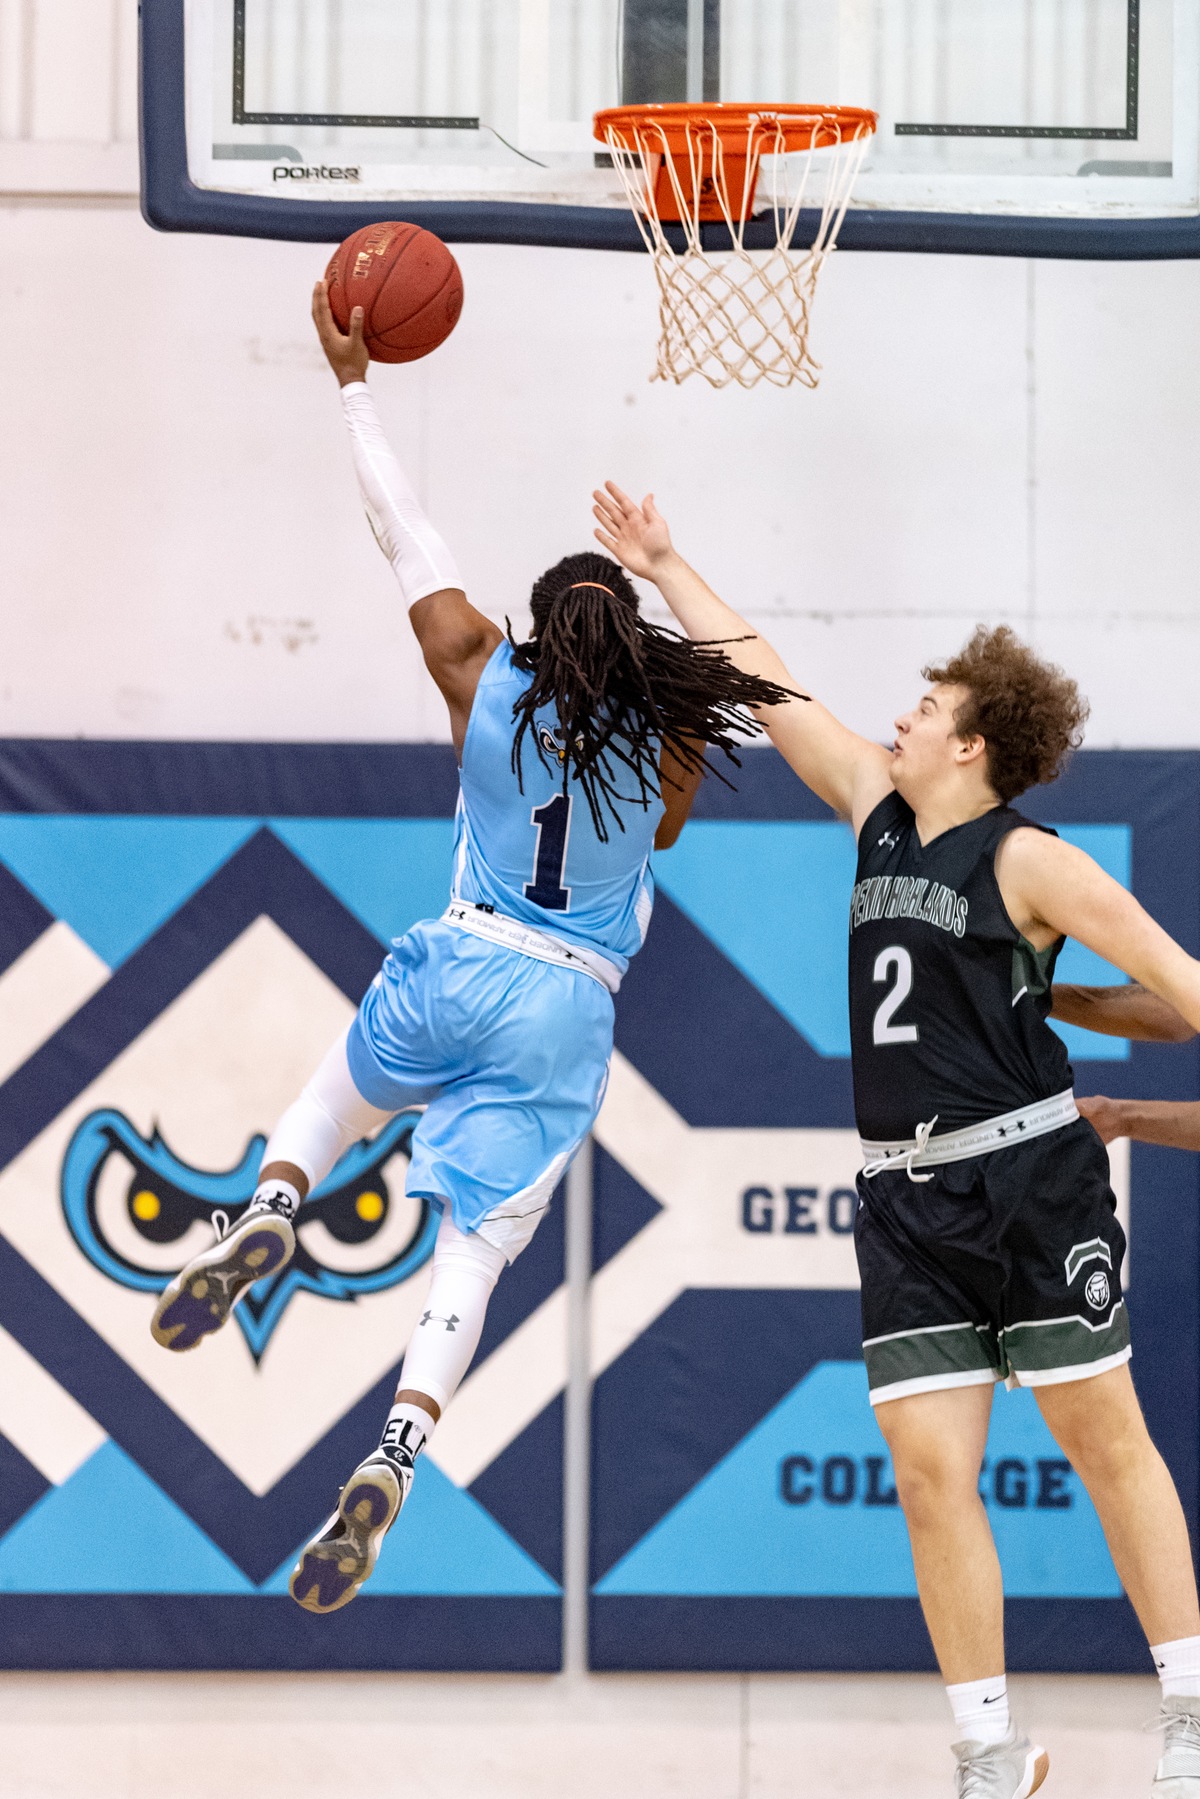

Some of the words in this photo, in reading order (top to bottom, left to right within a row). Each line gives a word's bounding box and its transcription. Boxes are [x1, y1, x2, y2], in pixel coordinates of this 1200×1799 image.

[522, 793, 573, 914] 1
[872, 946, 919, 1046] 2
[741, 1186, 859, 1234] GEO
[779, 1455, 1073, 1510] COLGE
